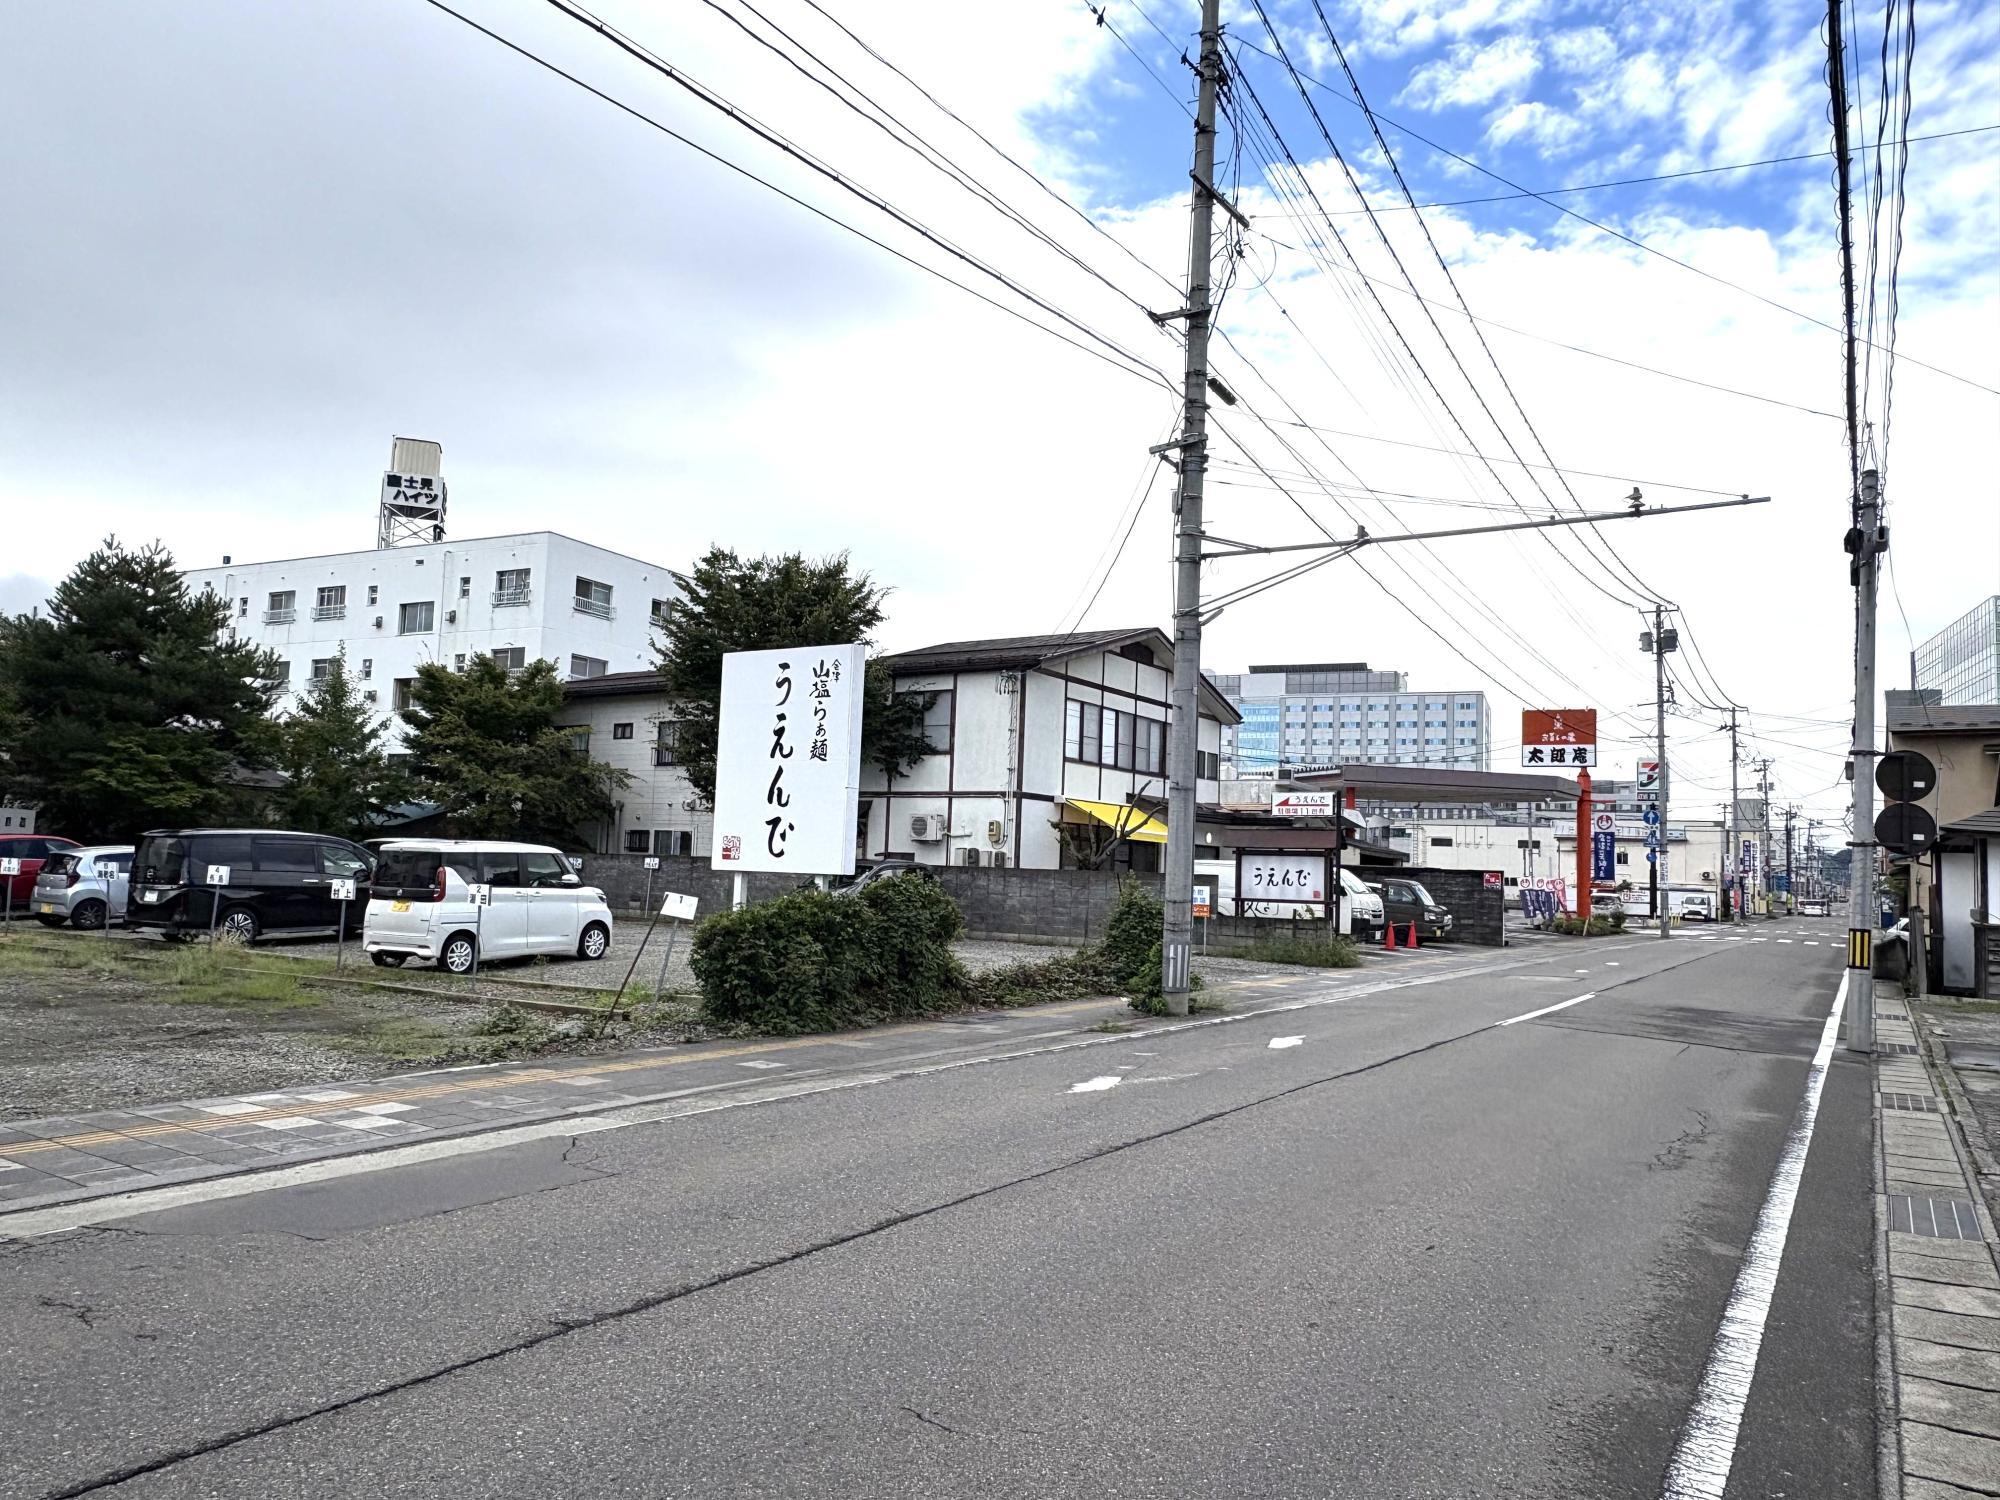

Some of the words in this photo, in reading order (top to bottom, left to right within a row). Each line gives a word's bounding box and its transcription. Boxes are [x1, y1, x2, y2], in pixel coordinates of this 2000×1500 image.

[393, 489, 439, 505] ハイツ
[765, 661, 795, 859] うえんで
[1528, 746, 1588, 764] 太郎庵
[1295, 795, 1326, 803] うえんで
[214, 866, 220, 874] 4
[1254, 867, 1310, 887] うえんで
[340, 880, 346, 888] 3
[476, 885, 482, 894] 2
[333, 888, 352, 899] 村上
